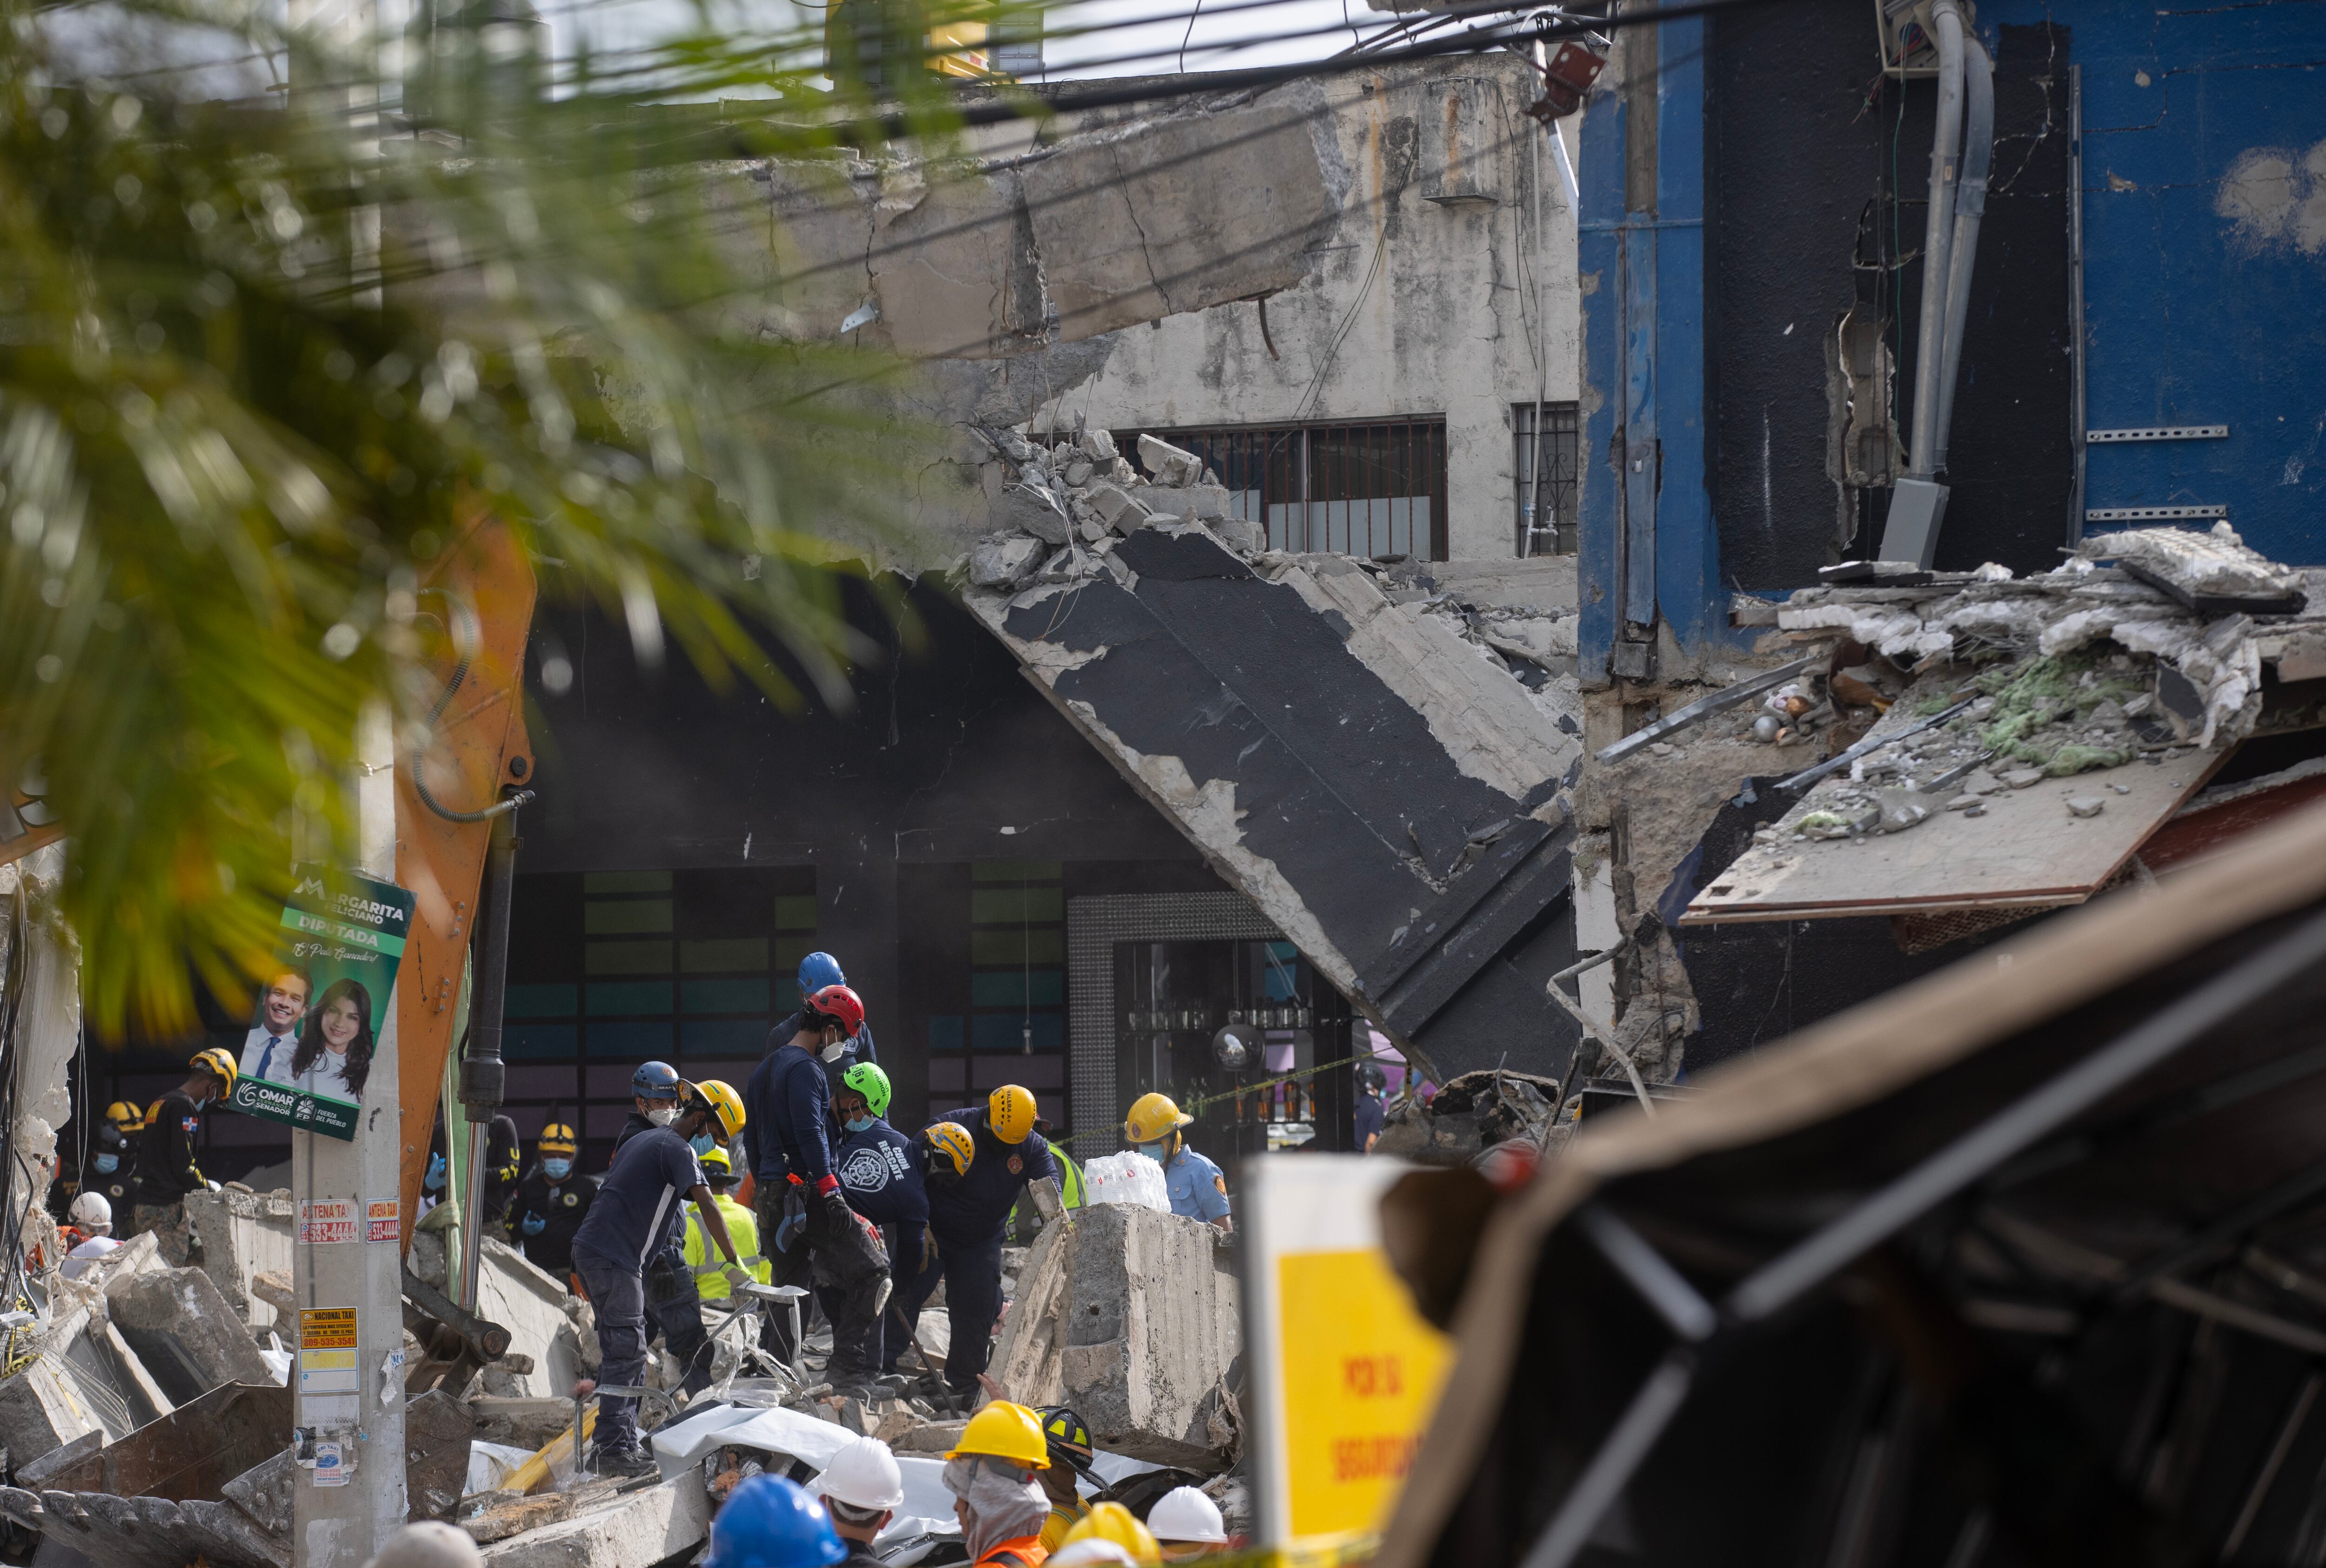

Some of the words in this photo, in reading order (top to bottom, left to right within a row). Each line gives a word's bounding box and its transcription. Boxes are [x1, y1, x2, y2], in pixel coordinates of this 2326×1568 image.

[299, 915, 378, 947] DIPUTADA
[259, 1089, 294, 1107] OMAR
[256, 1102, 290, 1116] SENADOR
[317, 1109, 337, 1119] FUERZA
[326, 1118, 346, 1128] PUEBLO
[878, 1140, 904, 1181] RESCATE
[892, 1147, 910, 1170] CBDN
[369, 1203, 386, 1217] ANTENA
[388, 1202, 397, 1216] TAXI
[373, 1221, 398, 1239] 533-4444
[314, 1312, 341, 1320] NACIONAL
[342, 1311, 354, 1319] TAXI
[304, 1337, 354, 1346] 809-535-3541
